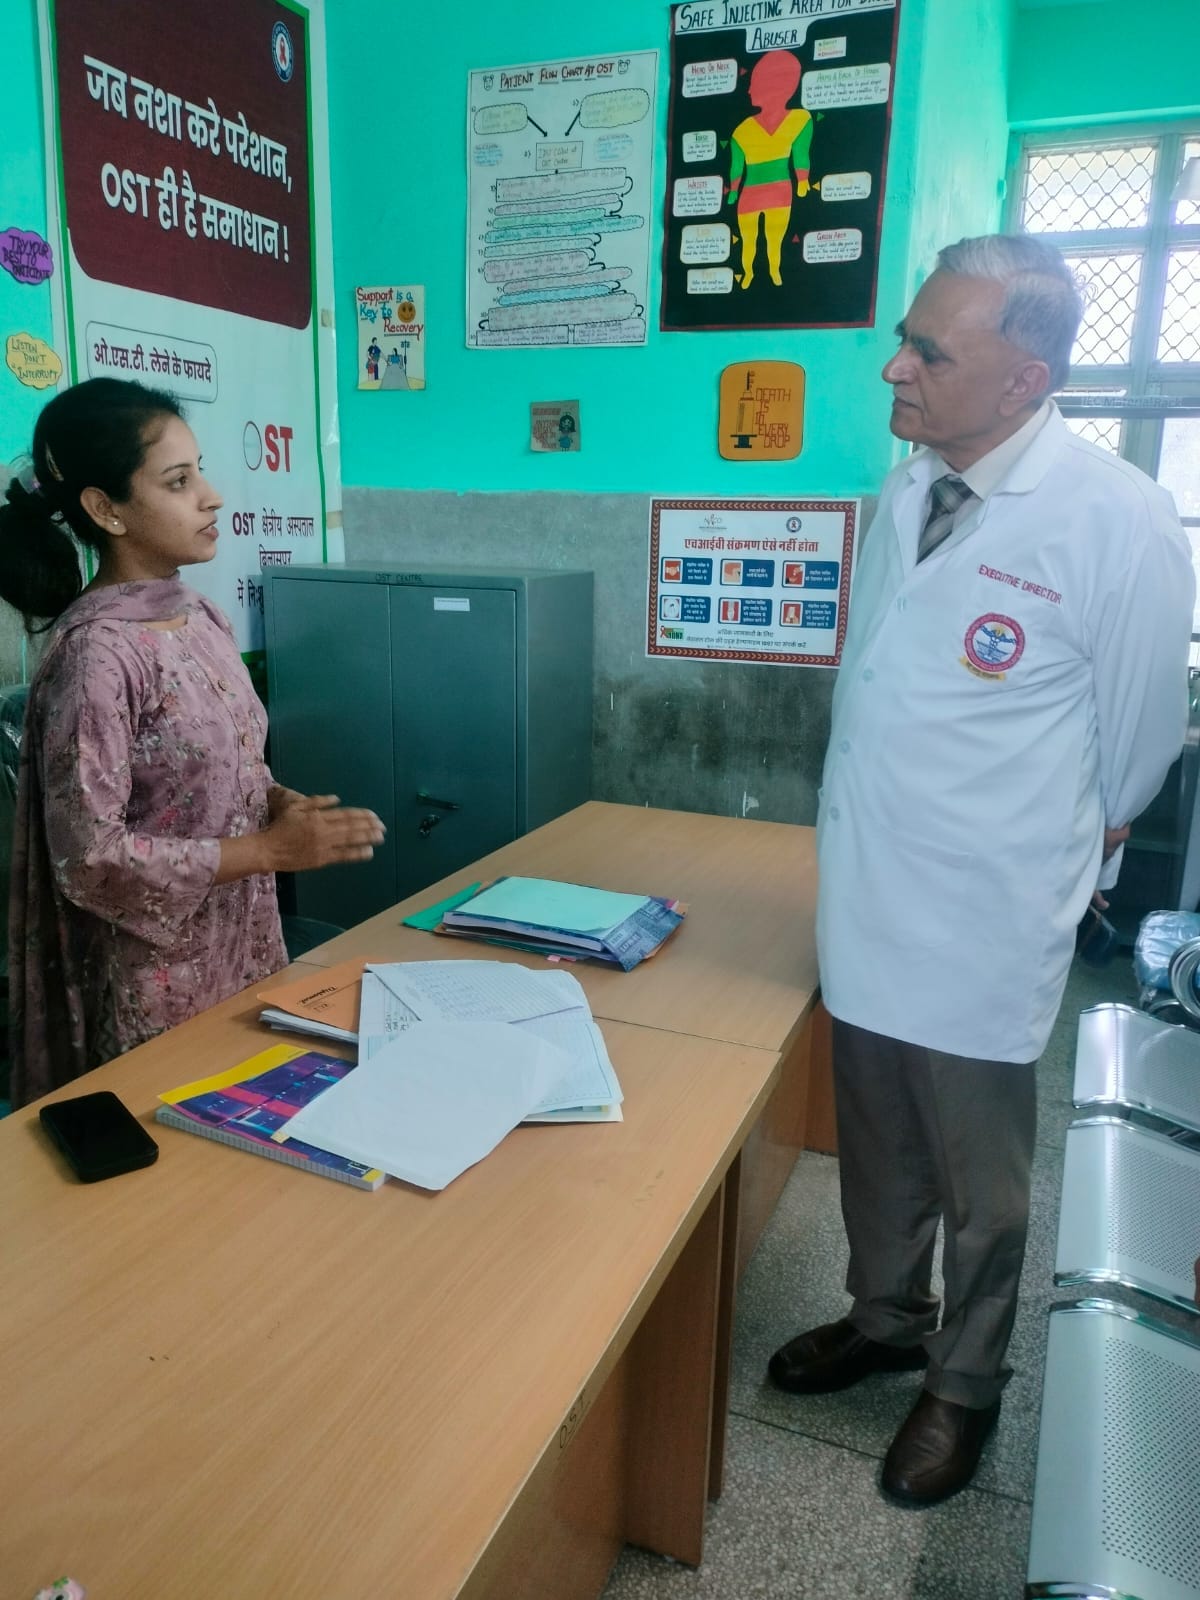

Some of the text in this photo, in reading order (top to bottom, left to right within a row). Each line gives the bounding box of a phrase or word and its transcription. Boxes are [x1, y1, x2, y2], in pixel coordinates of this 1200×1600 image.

[680, 4, 713, 30] SAFE
[721, 0, 782, 25] INJECTING
[751, 28, 798, 49] ABUSER
[84, 54, 292, 193] जब नशा करे परेशान,
[101, 163, 150, 217] OST
[154, 166, 178, 230] ही
[182, 169, 197, 238] है
[357, 287, 393, 306] Support
[360, 304, 378, 323] Key
[384, 317, 424, 341] Recovery
[172, 351, 182, 377] के
[183, 357, 212, 383] फायदे
[756, 387, 791, 402] DEATH
[232, 511, 255, 536] OST
[684, 535, 724, 551] एचआईवी
[727, 537, 760, 551] संक्रमण
[762, 536, 777, 552] ऐसे
[798, 538, 819, 553] होता
[978, 564, 1062, 604] EXECUTIVE DIRECTOR
